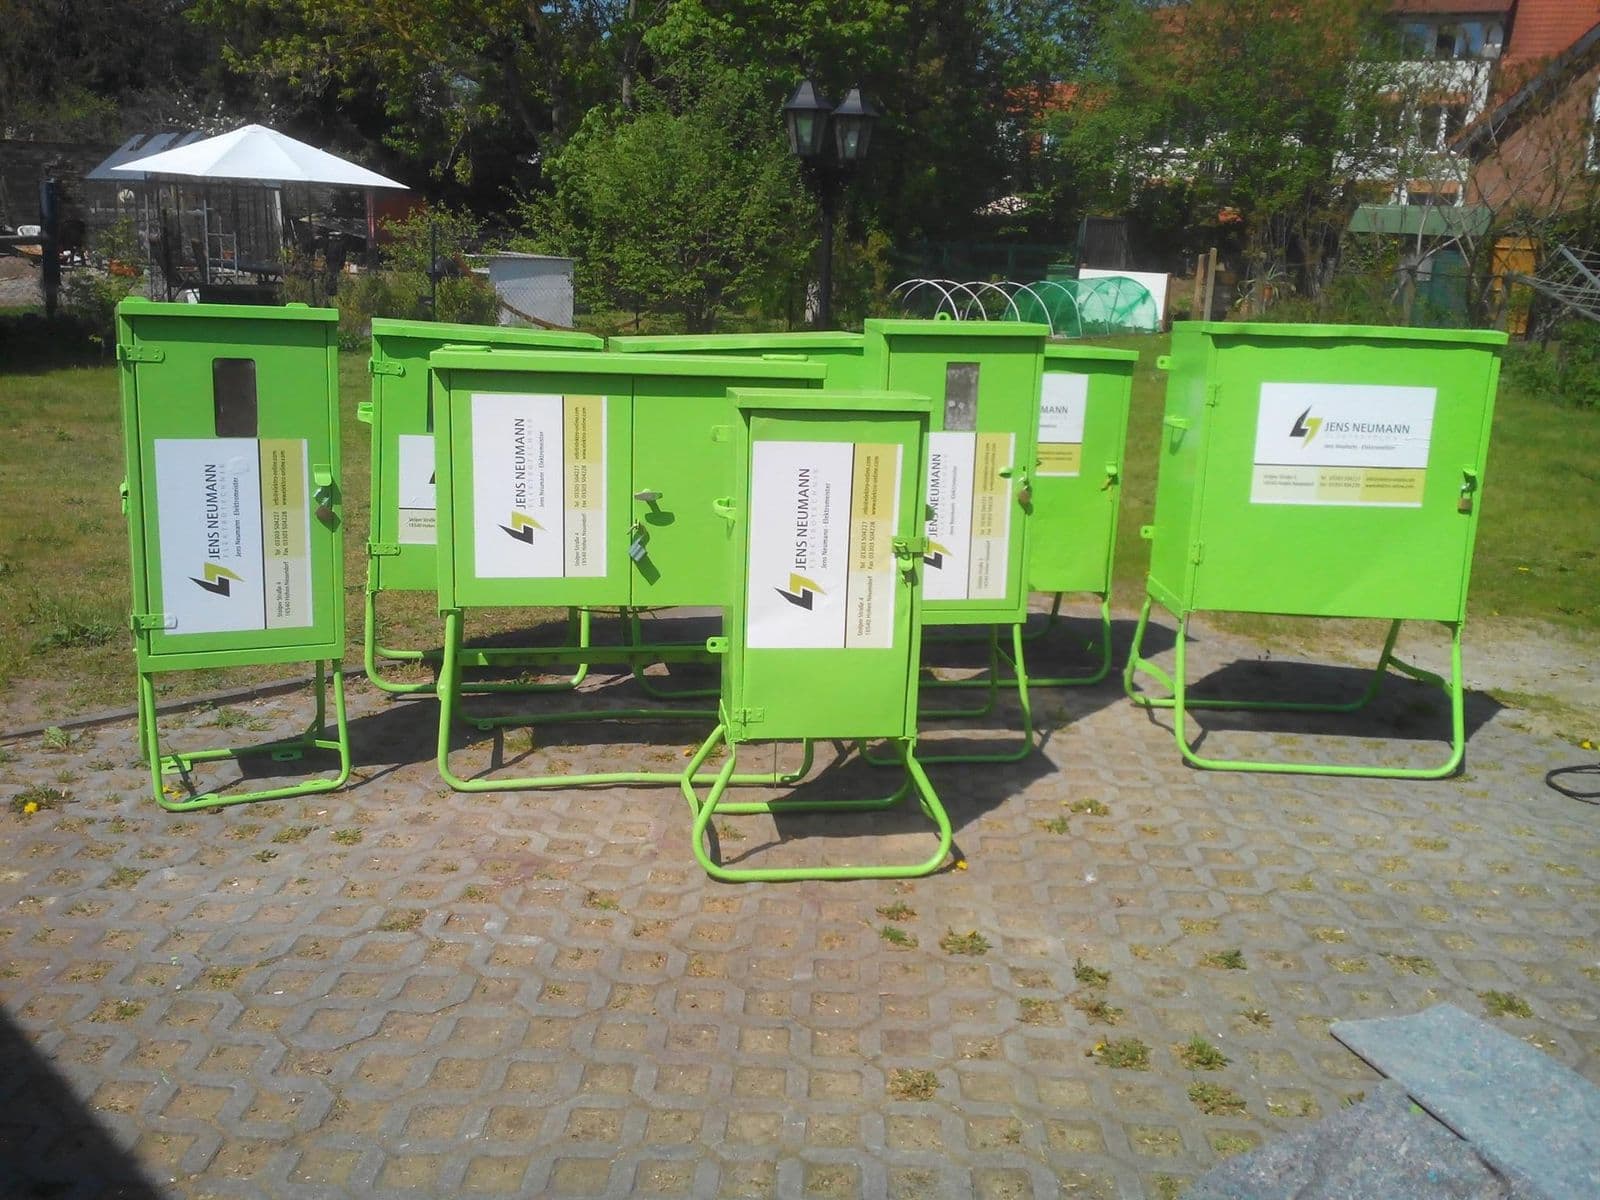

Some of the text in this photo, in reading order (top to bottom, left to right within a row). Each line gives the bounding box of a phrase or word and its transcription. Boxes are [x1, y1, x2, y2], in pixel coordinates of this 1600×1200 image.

[514, 418, 526, 509] JENS NEUMANN
[1324, 422, 1410, 434] JENS NEUMANN
[205, 464, 220, 559] JENS NEUMANN
[796, 469, 810, 570] JENS NEUMANN
[929, 454, 941, 510] NEUMANN
